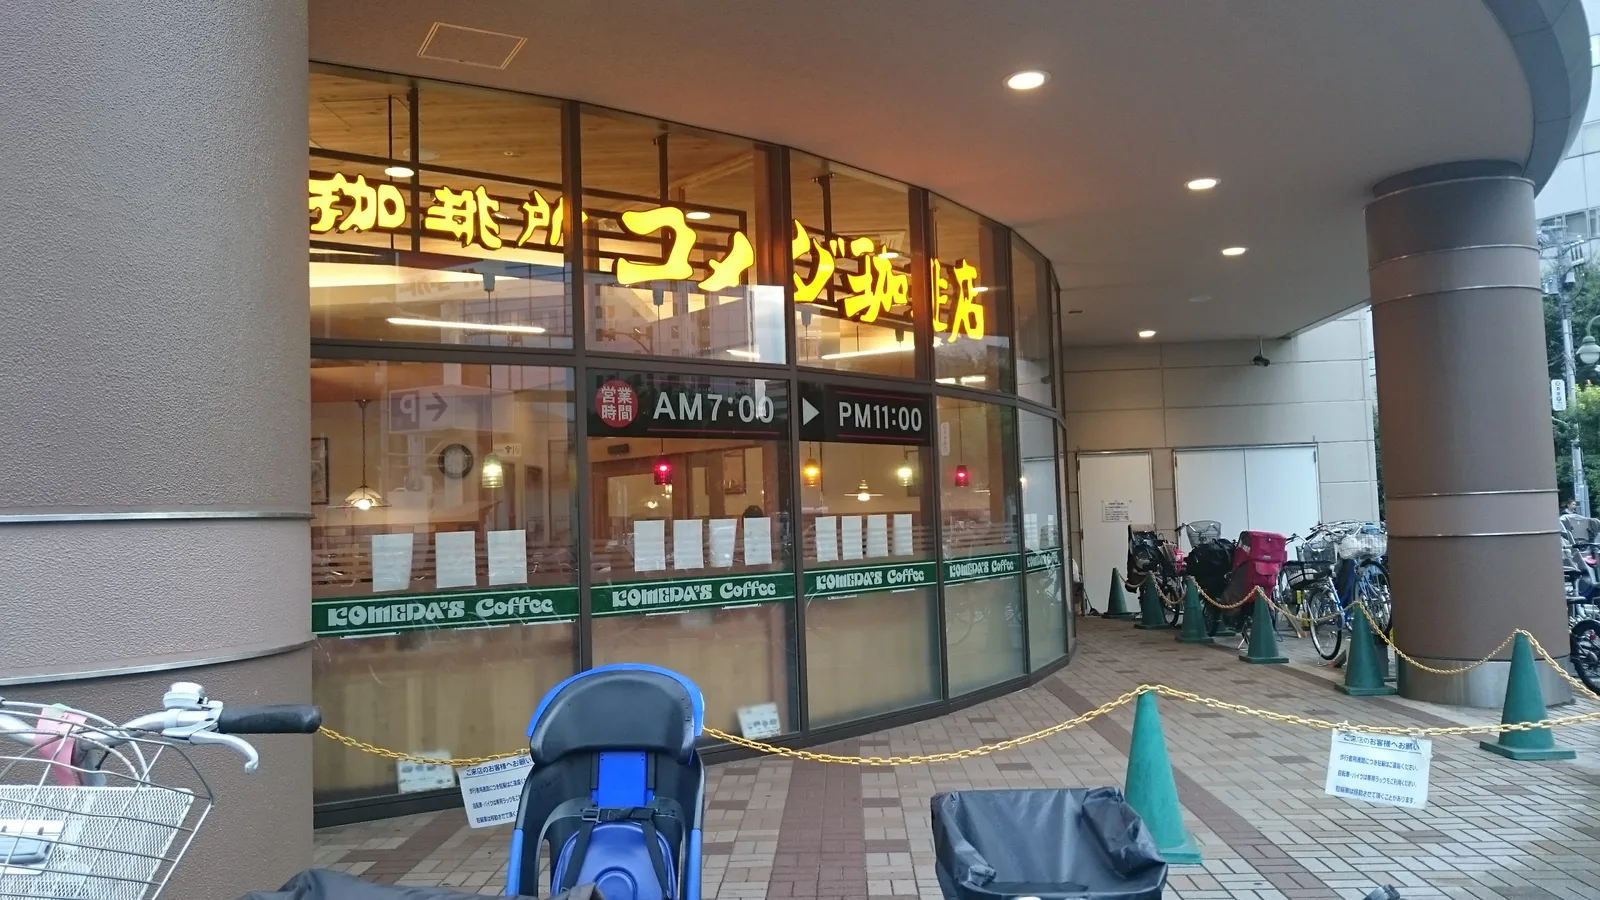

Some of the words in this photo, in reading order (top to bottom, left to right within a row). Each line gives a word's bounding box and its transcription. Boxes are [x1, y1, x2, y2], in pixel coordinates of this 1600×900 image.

[601, 385, 633, 404] 営業
[601, 404, 633, 422] 時間
[652, 391, 775, 424] AM7:00
[839, 401, 923, 432] PM11:00
[991, 559, 1014, 572] Coffee
[816, 570, 883, 591] KOMEDA'S
[886, 568, 925, 584] Coffee
[612, 583, 713, 608] KOMEDA'S
[719, 580, 776, 600] Coffee
[327, 600, 465, 627] KOMEDA'S
[475, 595, 554, 618] Coffee
